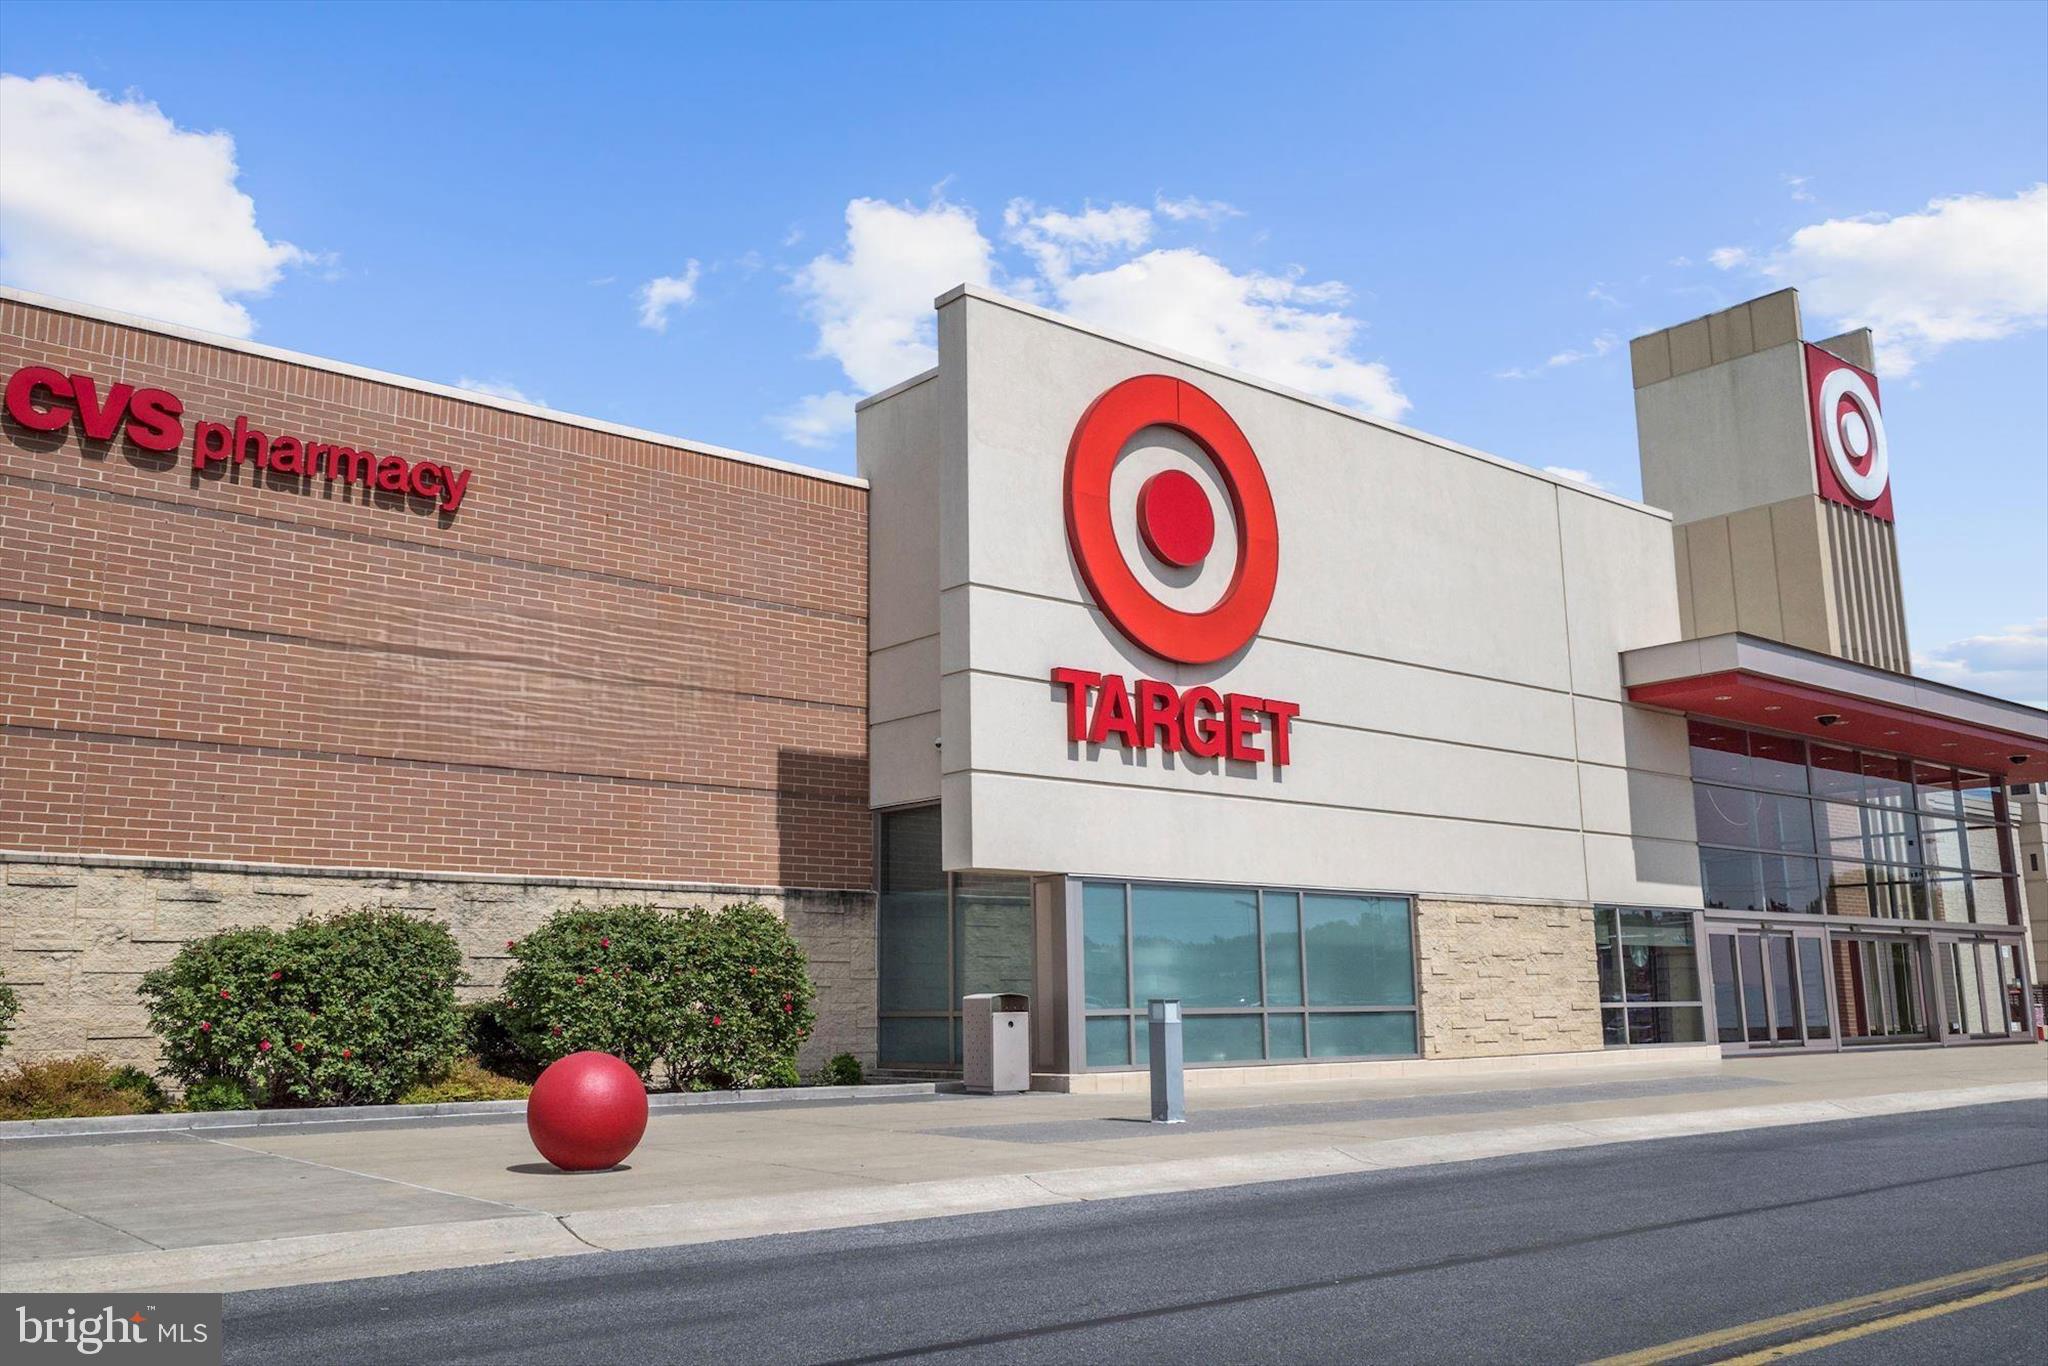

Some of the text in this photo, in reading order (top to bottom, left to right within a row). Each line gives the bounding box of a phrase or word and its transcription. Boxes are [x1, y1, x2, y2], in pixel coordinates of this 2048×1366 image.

[5, 366, 472, 511] CVS pharmacy
[1051, 667, 1300, 766] TARGET
